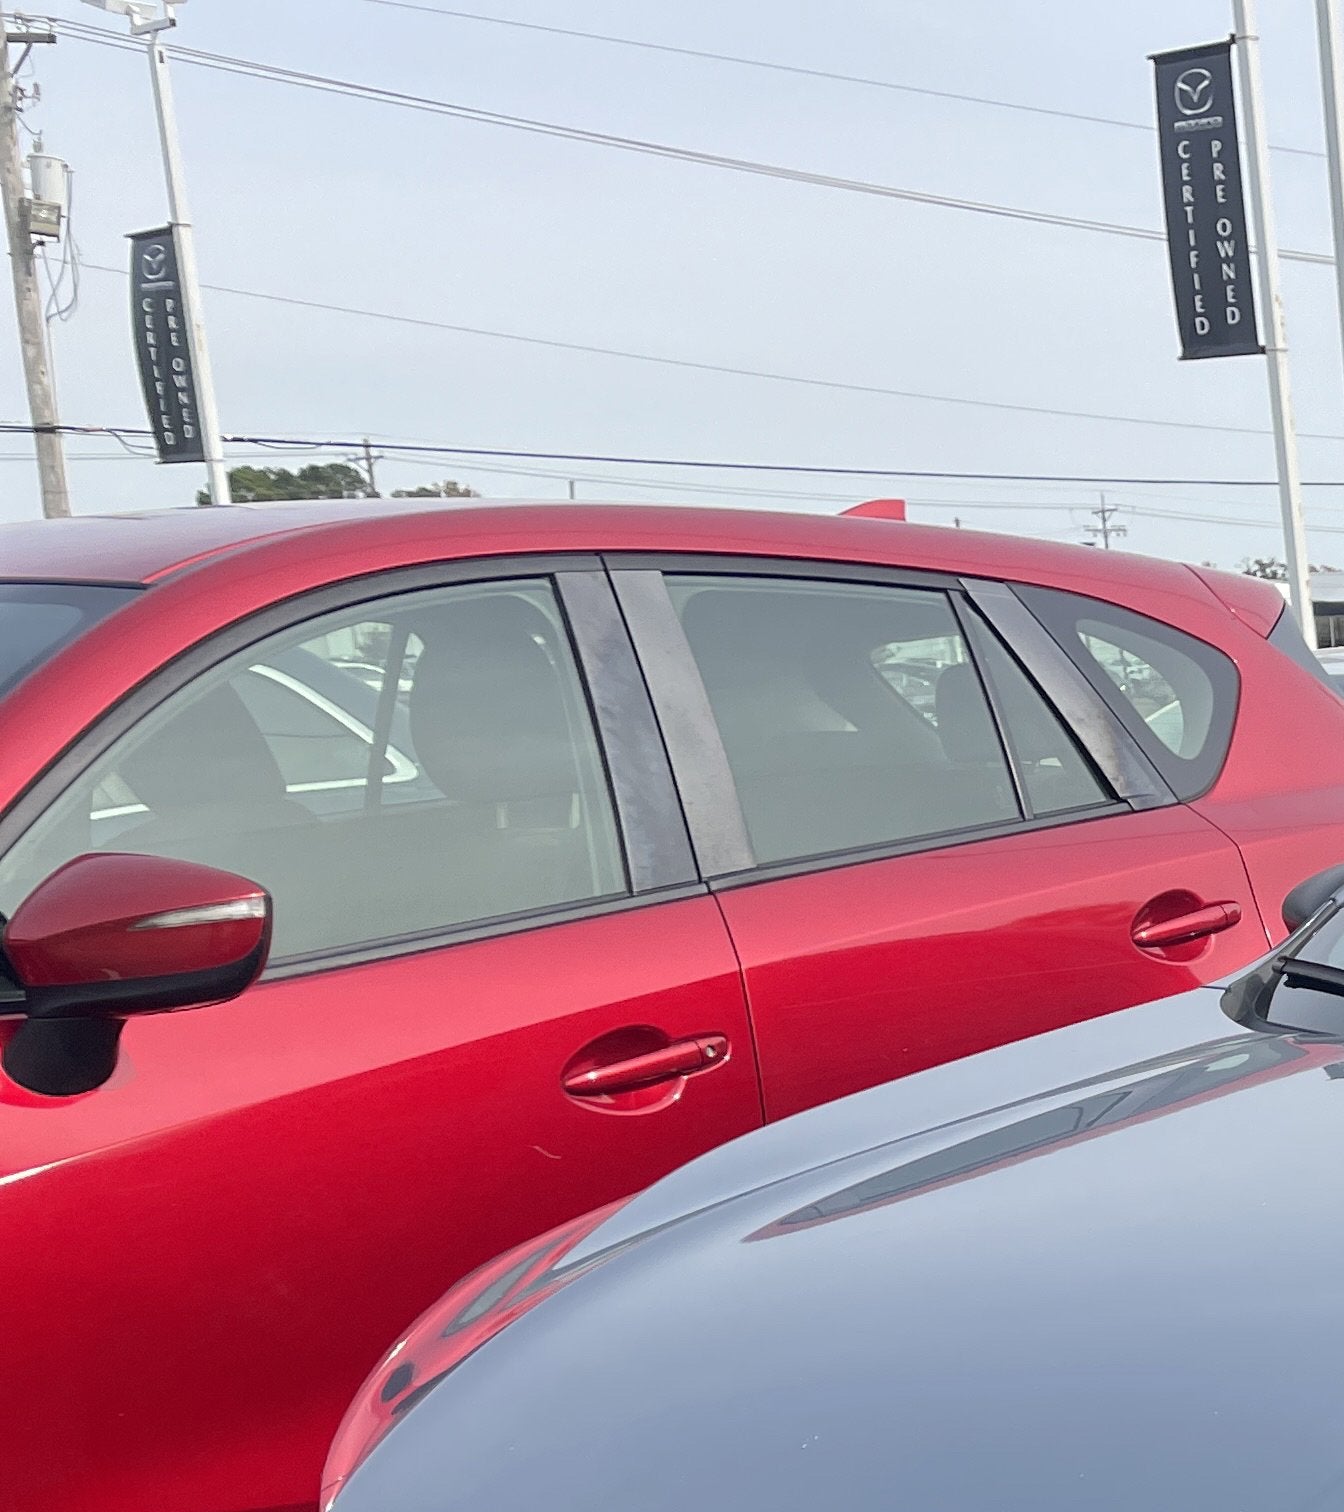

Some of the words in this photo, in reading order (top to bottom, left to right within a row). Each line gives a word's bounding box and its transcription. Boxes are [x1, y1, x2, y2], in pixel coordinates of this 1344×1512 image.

[1211, 140, 1227, 204] PRE
[1177, 140, 1210, 335] CERTIFIED
[1216, 217, 1241, 325] OWNED
